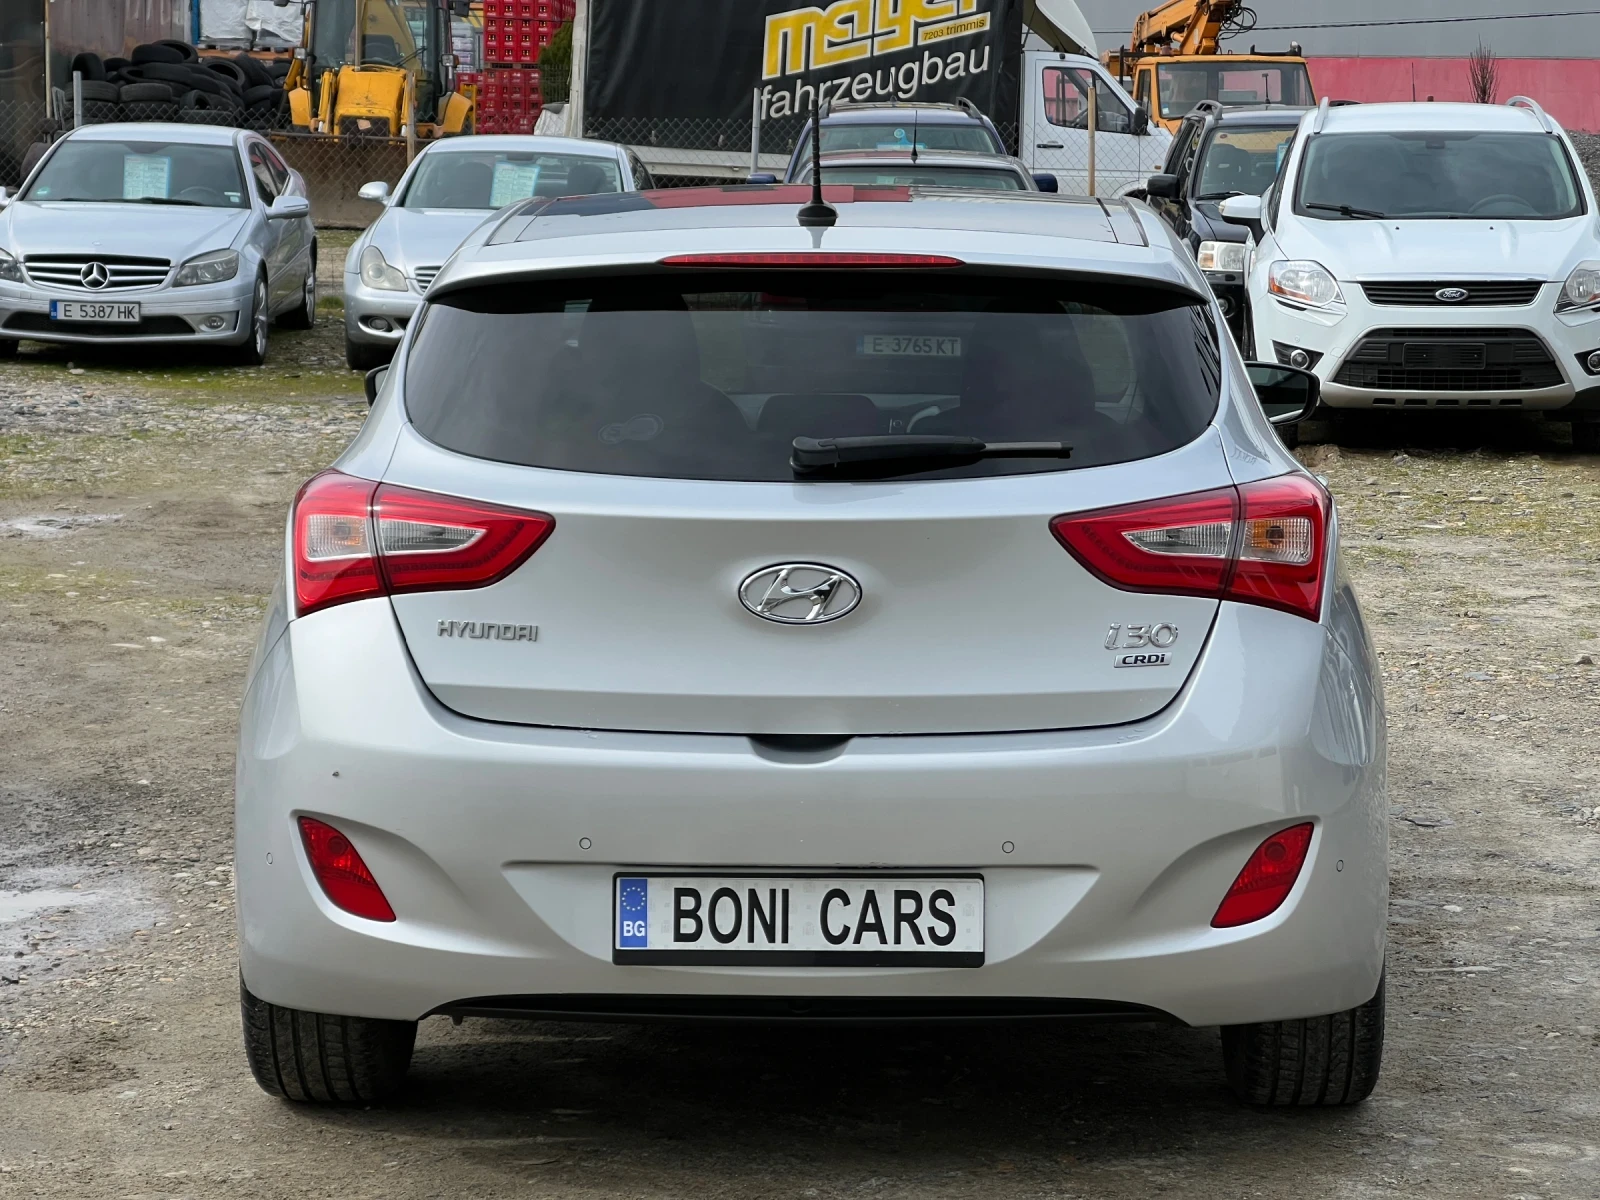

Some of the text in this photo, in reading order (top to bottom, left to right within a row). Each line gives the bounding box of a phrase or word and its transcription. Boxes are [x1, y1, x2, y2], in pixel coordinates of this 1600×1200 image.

[762, 0, 977, 80] may
[923, 18, 985, 41] 7203 trimmis
[761, 46, 989, 120] fahrzeugbau
[63, 303, 136, 320] E 5387 HK
[873, 337, 958, 355] E 3765 KT
[437, 620, 538, 642] HYUNDAI
[1104, 622, 1178, 650] i30
[1122, 654, 1166, 665] CRDi
[673, 887, 957, 946] BONI CARS
[623, 921, 645, 936] BG
